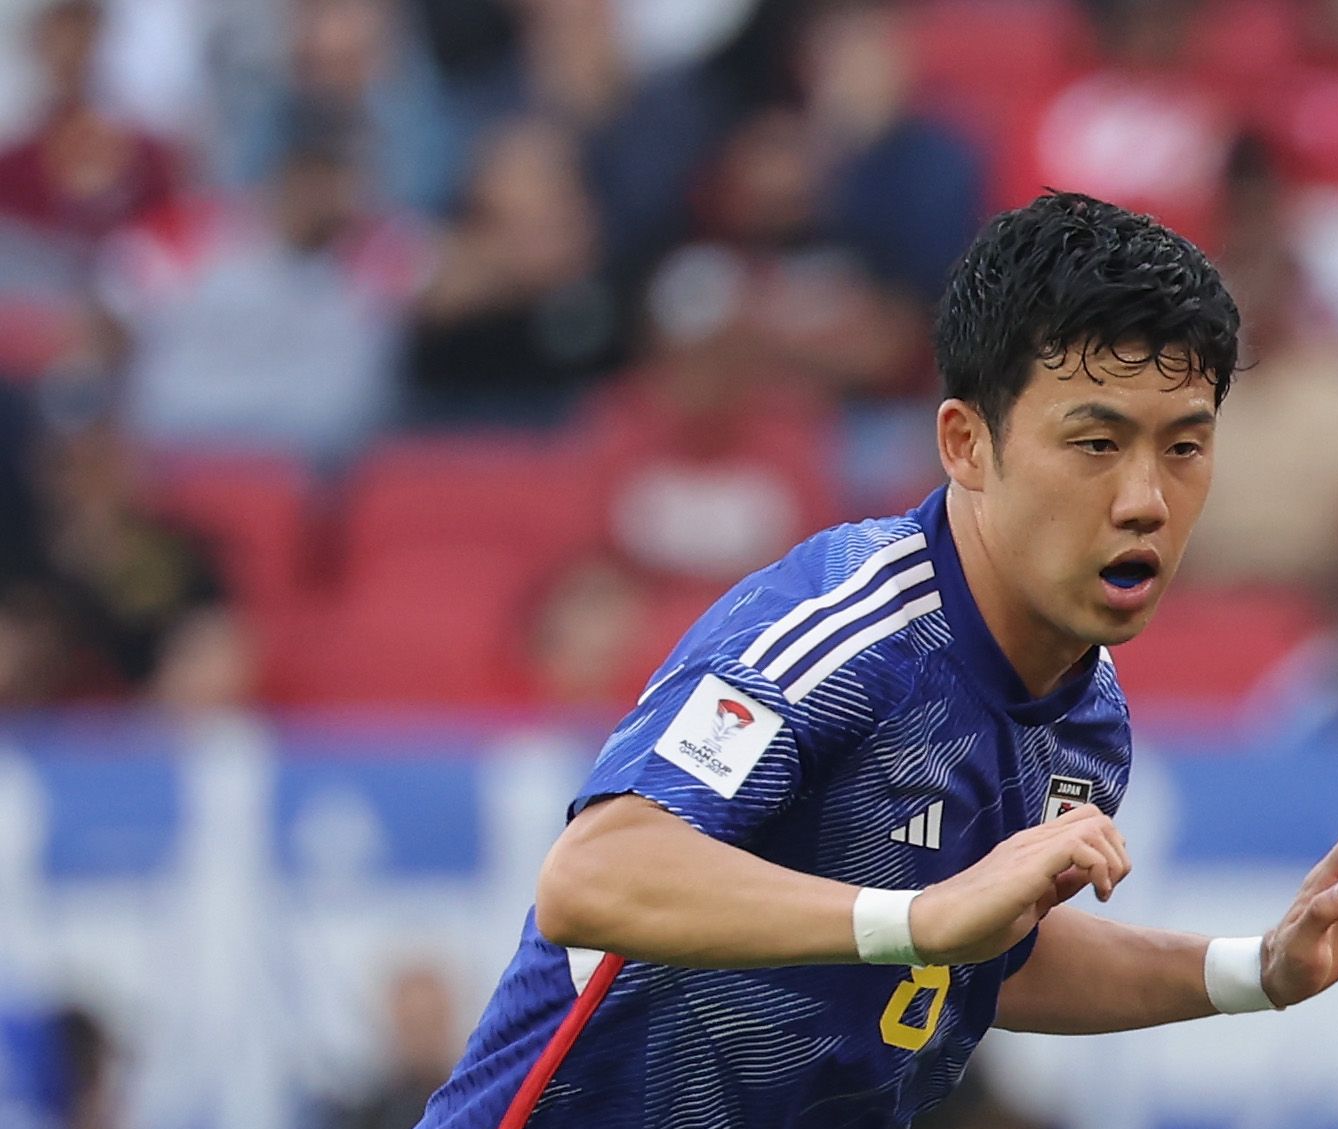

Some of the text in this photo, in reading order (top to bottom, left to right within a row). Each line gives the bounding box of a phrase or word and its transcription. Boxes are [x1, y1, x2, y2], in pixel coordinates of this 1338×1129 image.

[680, 740, 732, 773] ASIAN CUP
[1058, 783, 1081, 796] JAPAN
[880, 965, 951, 1052] 8
